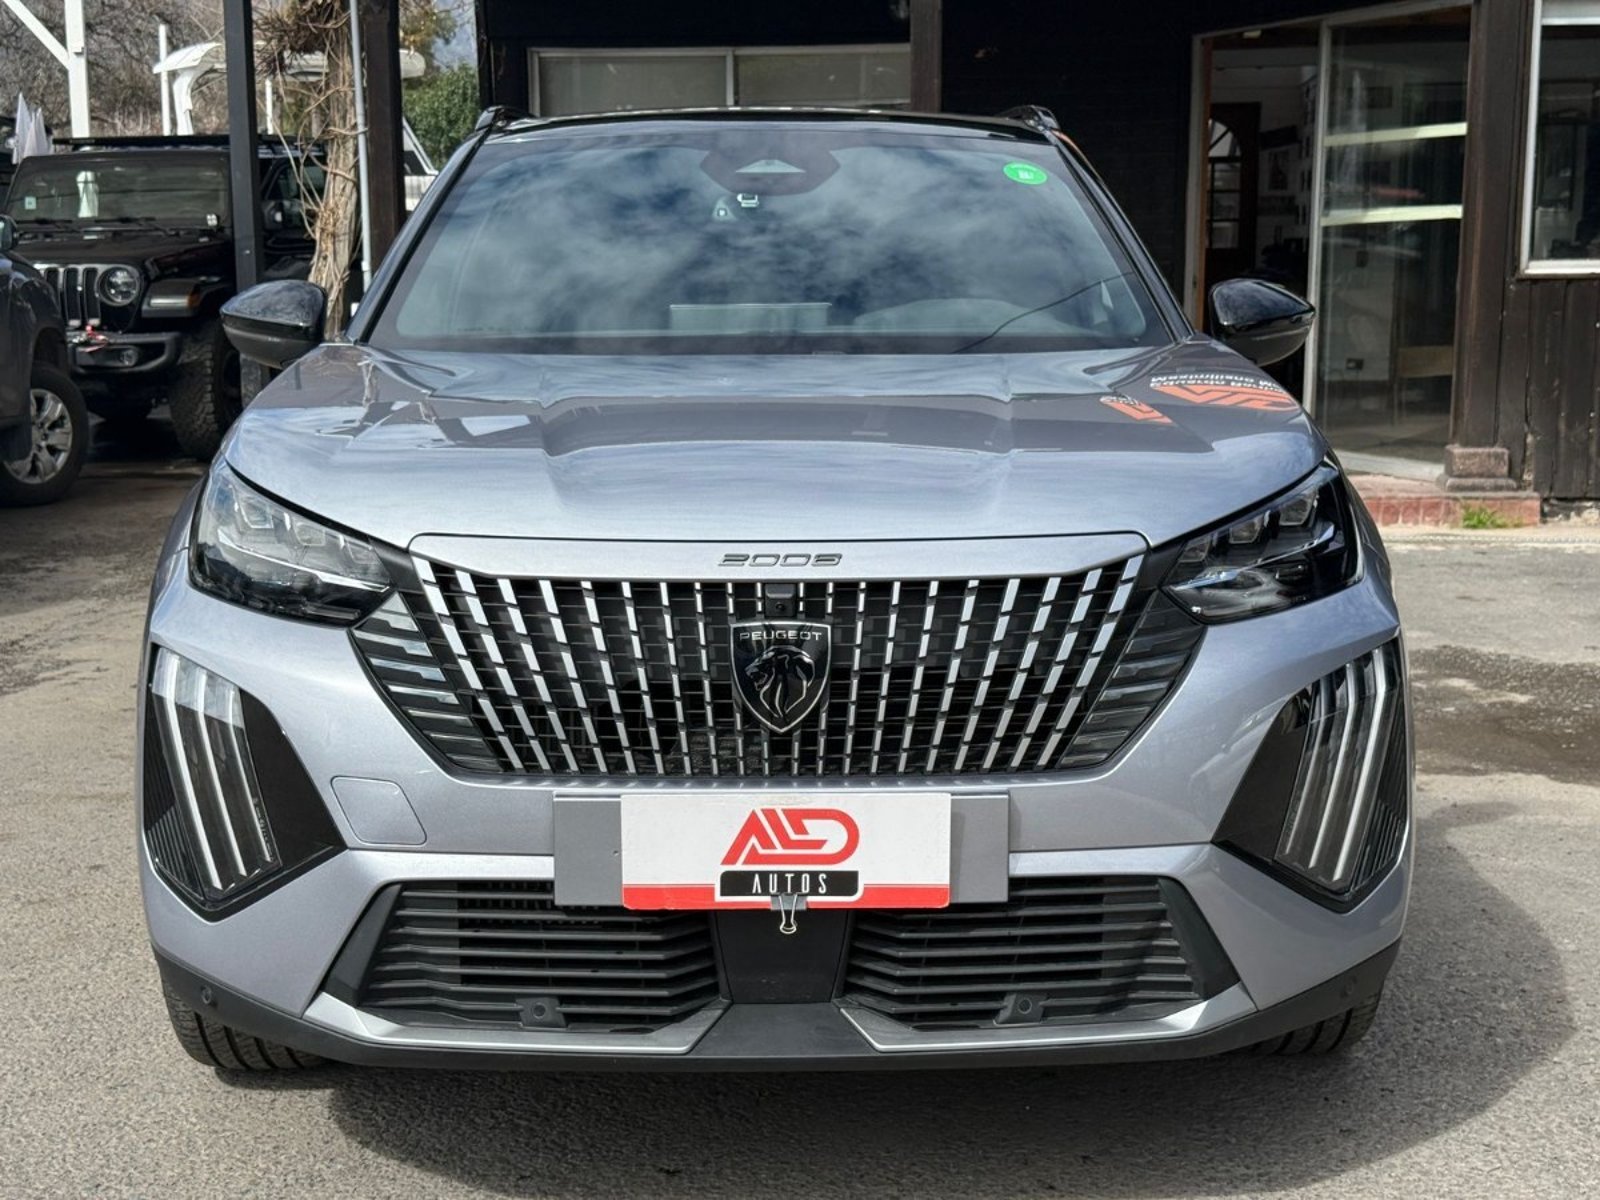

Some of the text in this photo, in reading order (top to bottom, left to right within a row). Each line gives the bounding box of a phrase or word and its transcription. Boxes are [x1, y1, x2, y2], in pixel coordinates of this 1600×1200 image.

[718, 552, 842, 567] 2008
[739, 629, 823, 642] PEUGEOT
[720, 807, 860, 866] ALD
[751, 872, 827, 895] AUTOS
